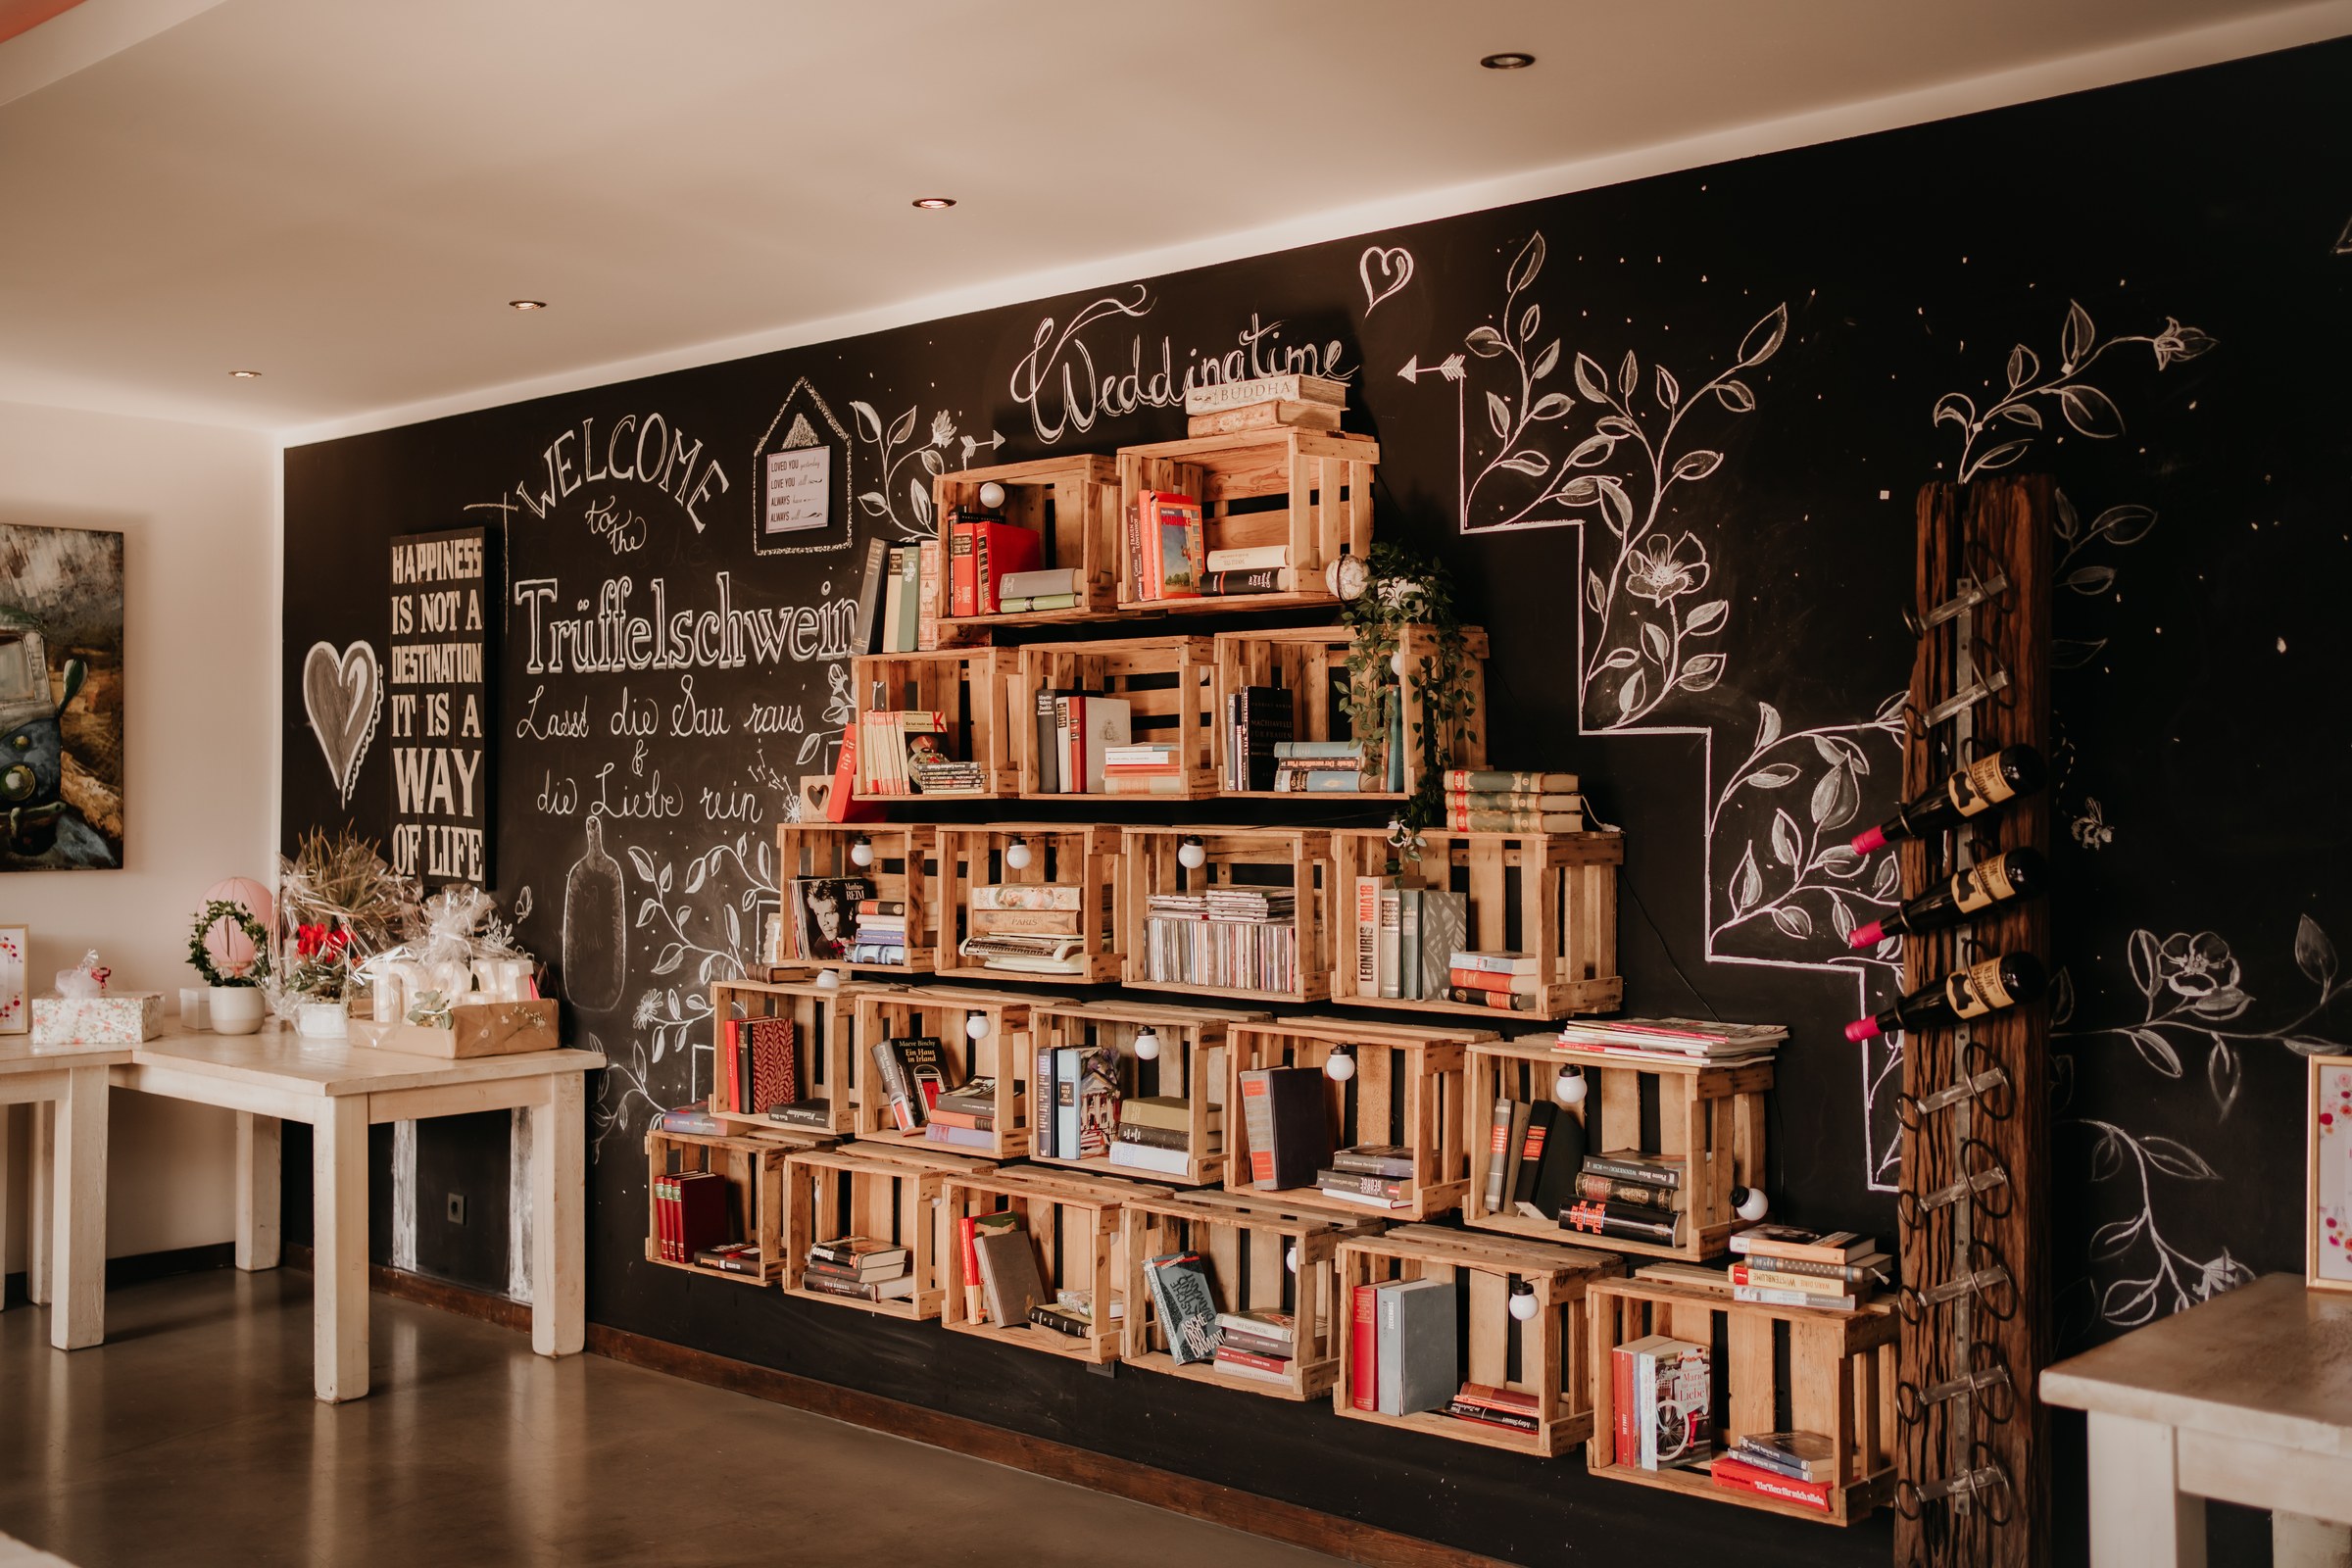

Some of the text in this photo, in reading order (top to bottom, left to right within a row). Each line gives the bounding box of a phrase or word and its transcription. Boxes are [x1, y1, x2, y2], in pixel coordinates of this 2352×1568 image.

[1220, 381, 1292, 402] BUDDHA
[515, 413, 730, 534] WELCOME
[770, 461, 788, 472] LOVED
[788, 459, 800, 470] YOU
[770, 478, 784, 490] LOVE
[785, 476, 796, 488] YOU
[770, 495, 791, 507] ALWAYS
[585, 495, 648, 555] to the
[770, 511, 790, 523] ALWAYS
[392, 537, 483, 586] HAPPINESS
[392, 589, 483, 635] IS NOT A
[514, 571, 859, 675] Trüffelschwein
[392, 643, 483, 684] DESTINATION
[392, 693, 483, 738] IT IS A
[610, 686, 660, 738] die
[742, 698, 805, 734] raus
[1250, 719, 1293, 729] MACHIAVELLI
[630, 739, 649, 778] &
[393, 747, 483, 818] WAY
[537, 770, 578, 815] die
[590, 762, 684, 821] Liebe
[393, 823, 483, 883] OF LIFE
[846, 890, 865, 901] REIM
[1359, 926, 1374, 954] URIS
[1359, 956, 1374, 982] LEON
[1607, 1165, 1637, 1177] WINNETOU
[1637, 1169, 1651, 1180] Brice
[1650, 1172, 1667, 1183] Pierre
[1358, 1176, 1382, 1192] GEORGE
[1569, 1204, 1579, 1224] JOHN
[1576, 1200, 1589, 1232] GRISHAM
[1585, 1206, 1595, 1226] DIE
[1592, 1202, 1606, 1235] FIRMA
[832, 1282, 850, 1292] TENDER
[1751, 1271, 1830, 1290] WARIS DIRIE WÜSTENBLUME
[1169, 1273, 1216, 1323] ASCHE UND DIAMANT
[1181, 1311, 1208, 1334] ASCHE
[1184, 1326, 1205, 1346] UND
[1191, 1328, 1226, 1358] DIAMANT
[1683, 1372, 1705, 1382] Marie
[1680, 1387, 1706, 1402] Liebe
[1500, 1416, 1531, 1429] Mary Stewart
[1764, 1482, 1783, 1495] Herz
[1779, 1486, 1793, 1497] für
[1791, 1488, 1808, 1501] mich
[1805, 1491, 1827, 1506] allein
